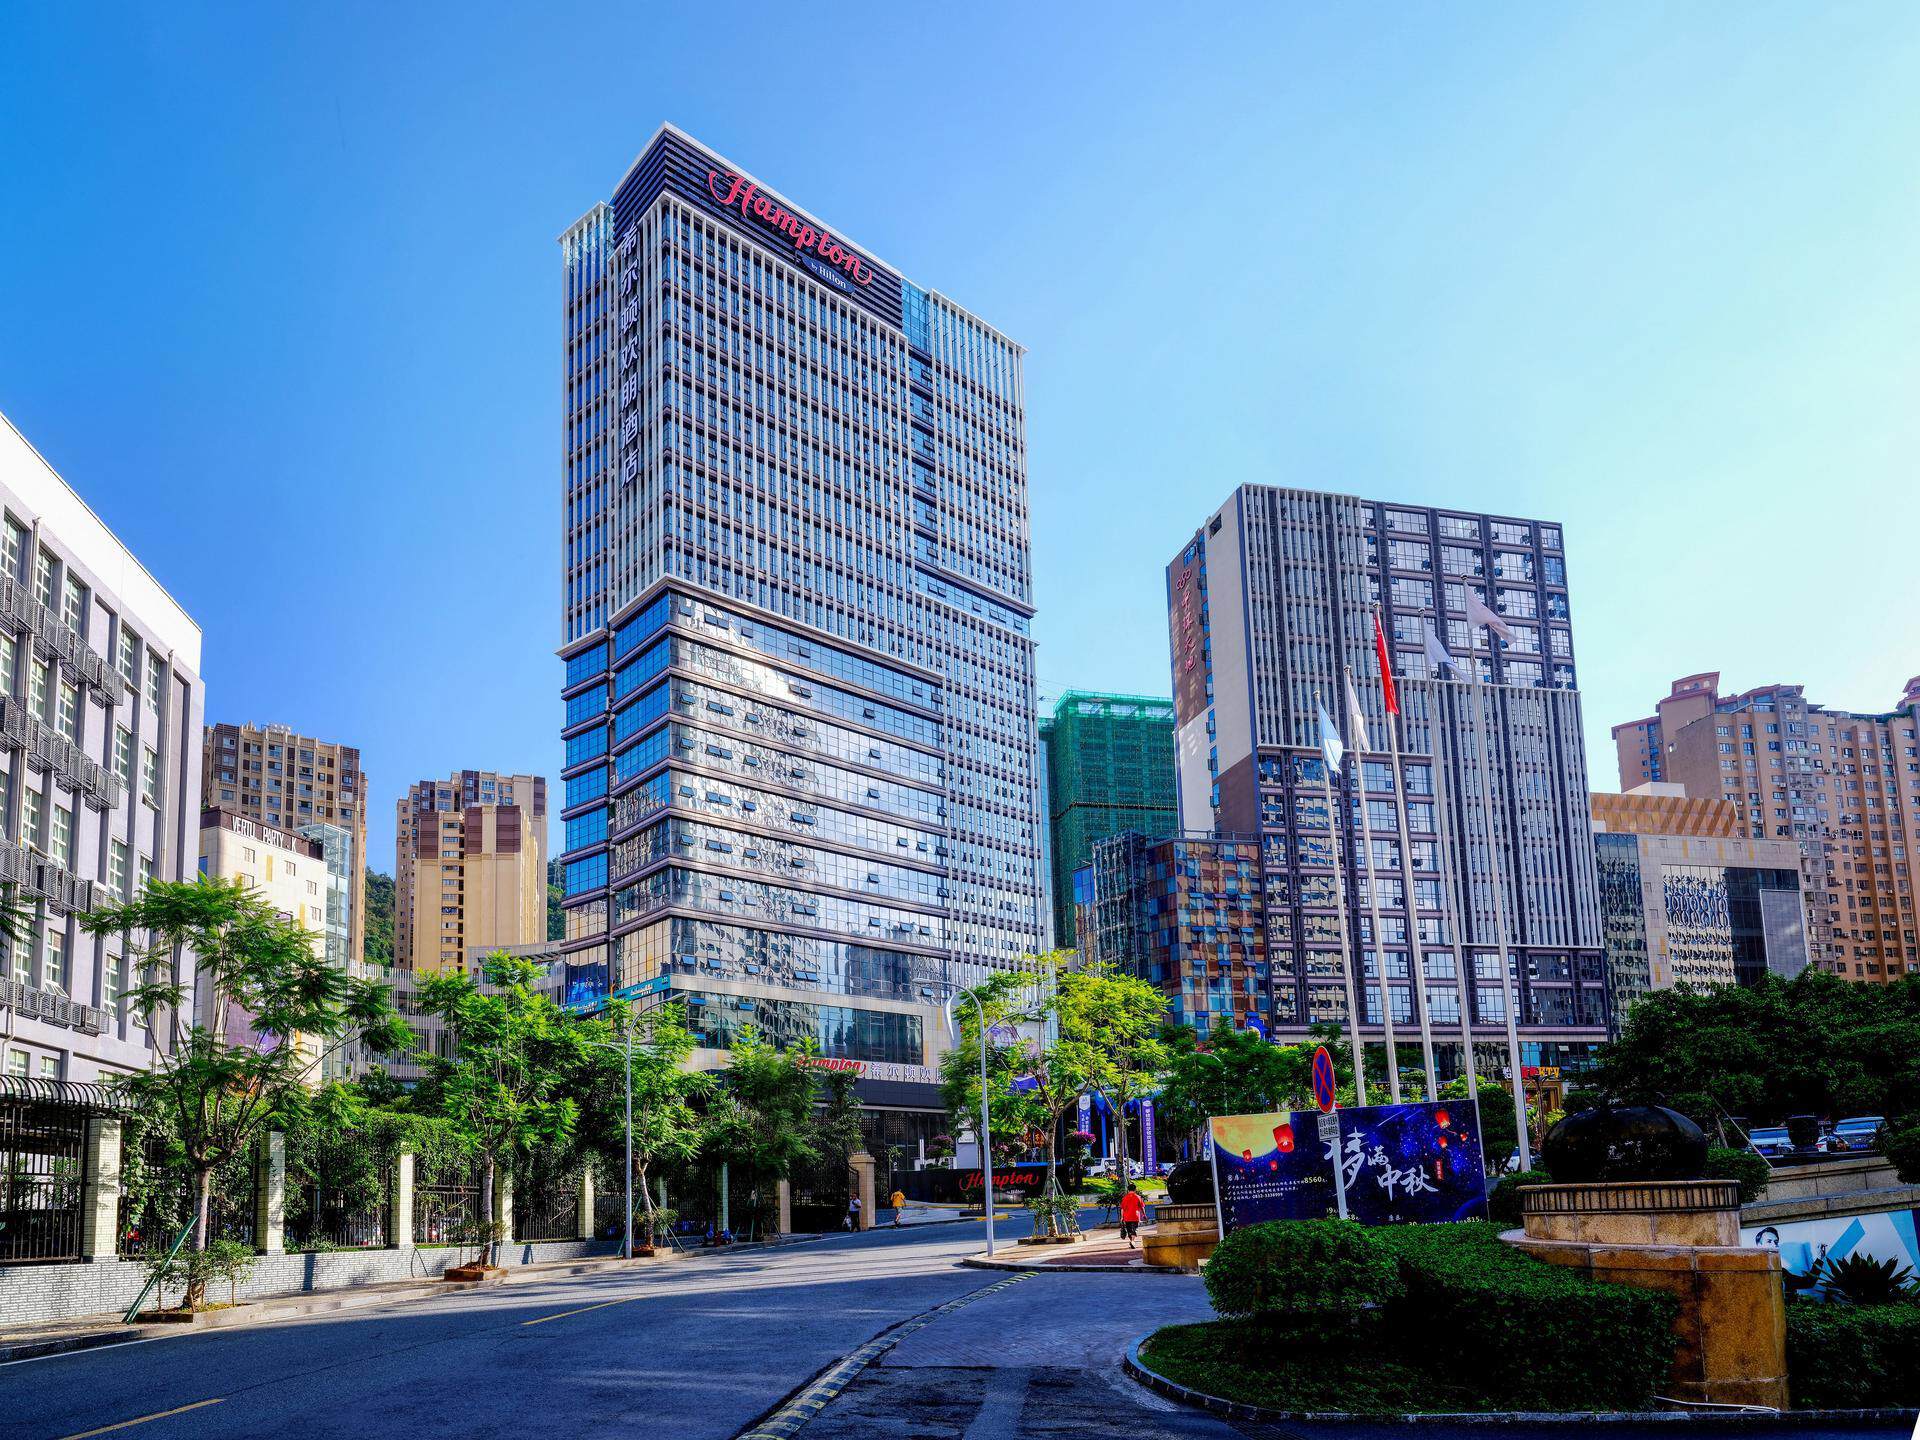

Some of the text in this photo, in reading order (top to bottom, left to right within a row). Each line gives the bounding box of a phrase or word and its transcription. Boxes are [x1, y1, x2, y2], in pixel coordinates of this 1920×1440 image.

[708, 170, 873, 286] Hampton
[811, 262, 846, 289] by Hilton
[621, 222, 639, 487] 希尔顿欢朋酒店
[232, 816, 256, 838] VERTU
